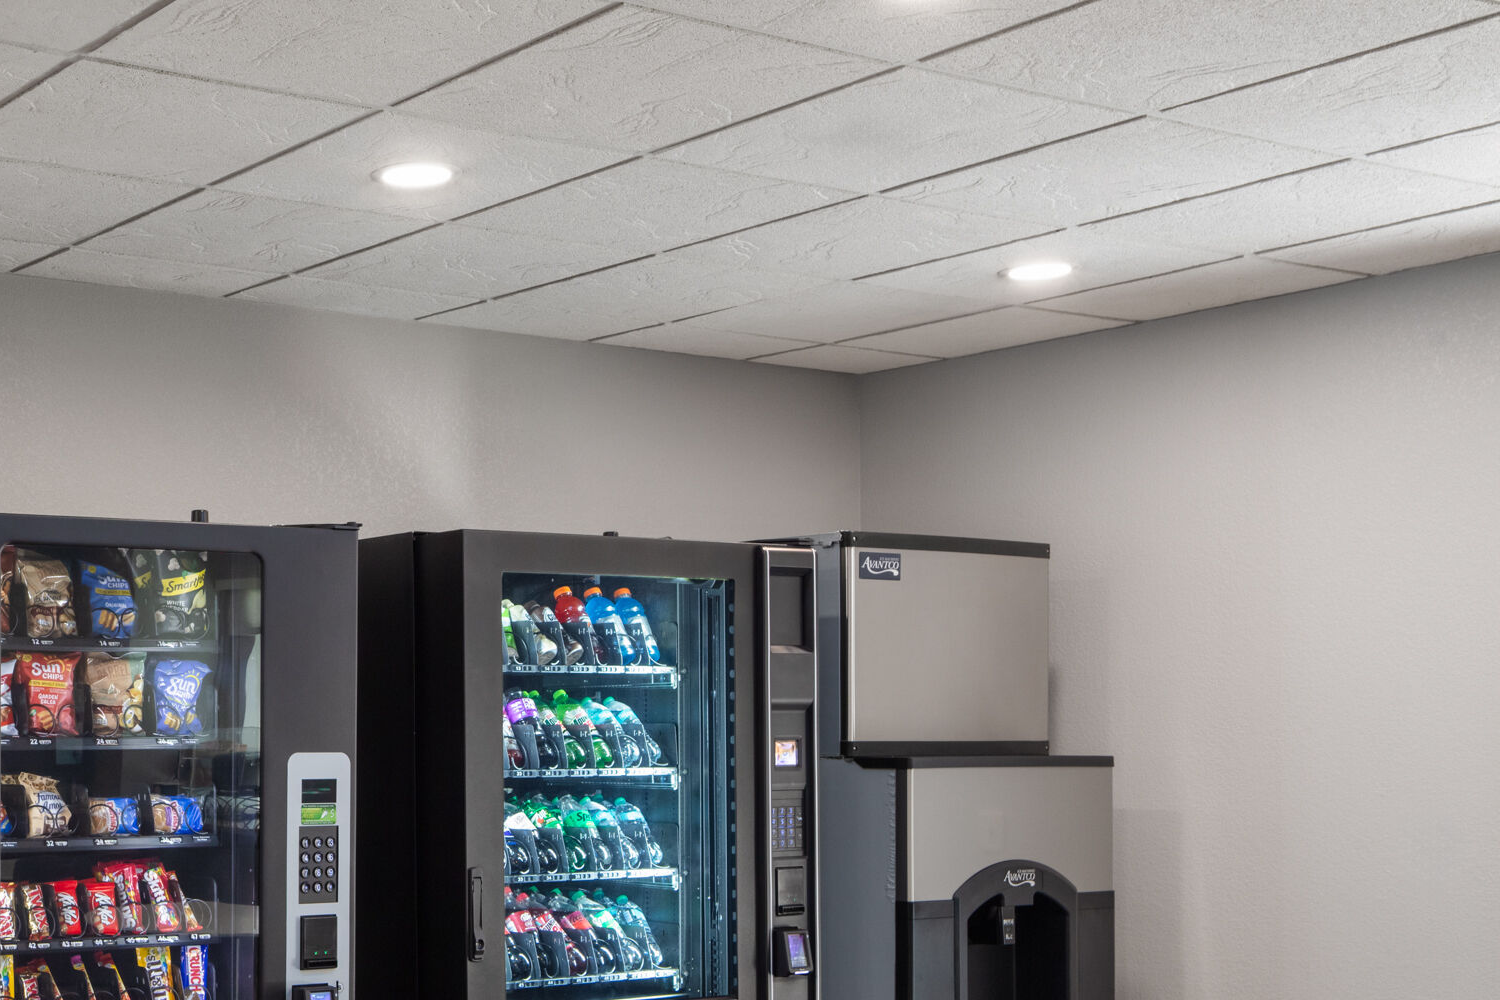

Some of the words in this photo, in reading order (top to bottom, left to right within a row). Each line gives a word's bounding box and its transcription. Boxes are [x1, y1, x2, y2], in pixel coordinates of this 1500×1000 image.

[31, 662, 61, 676] Sun
[42, 673, 64, 681] CHIPS
[188, 946, 203, 992] CRUNCH
